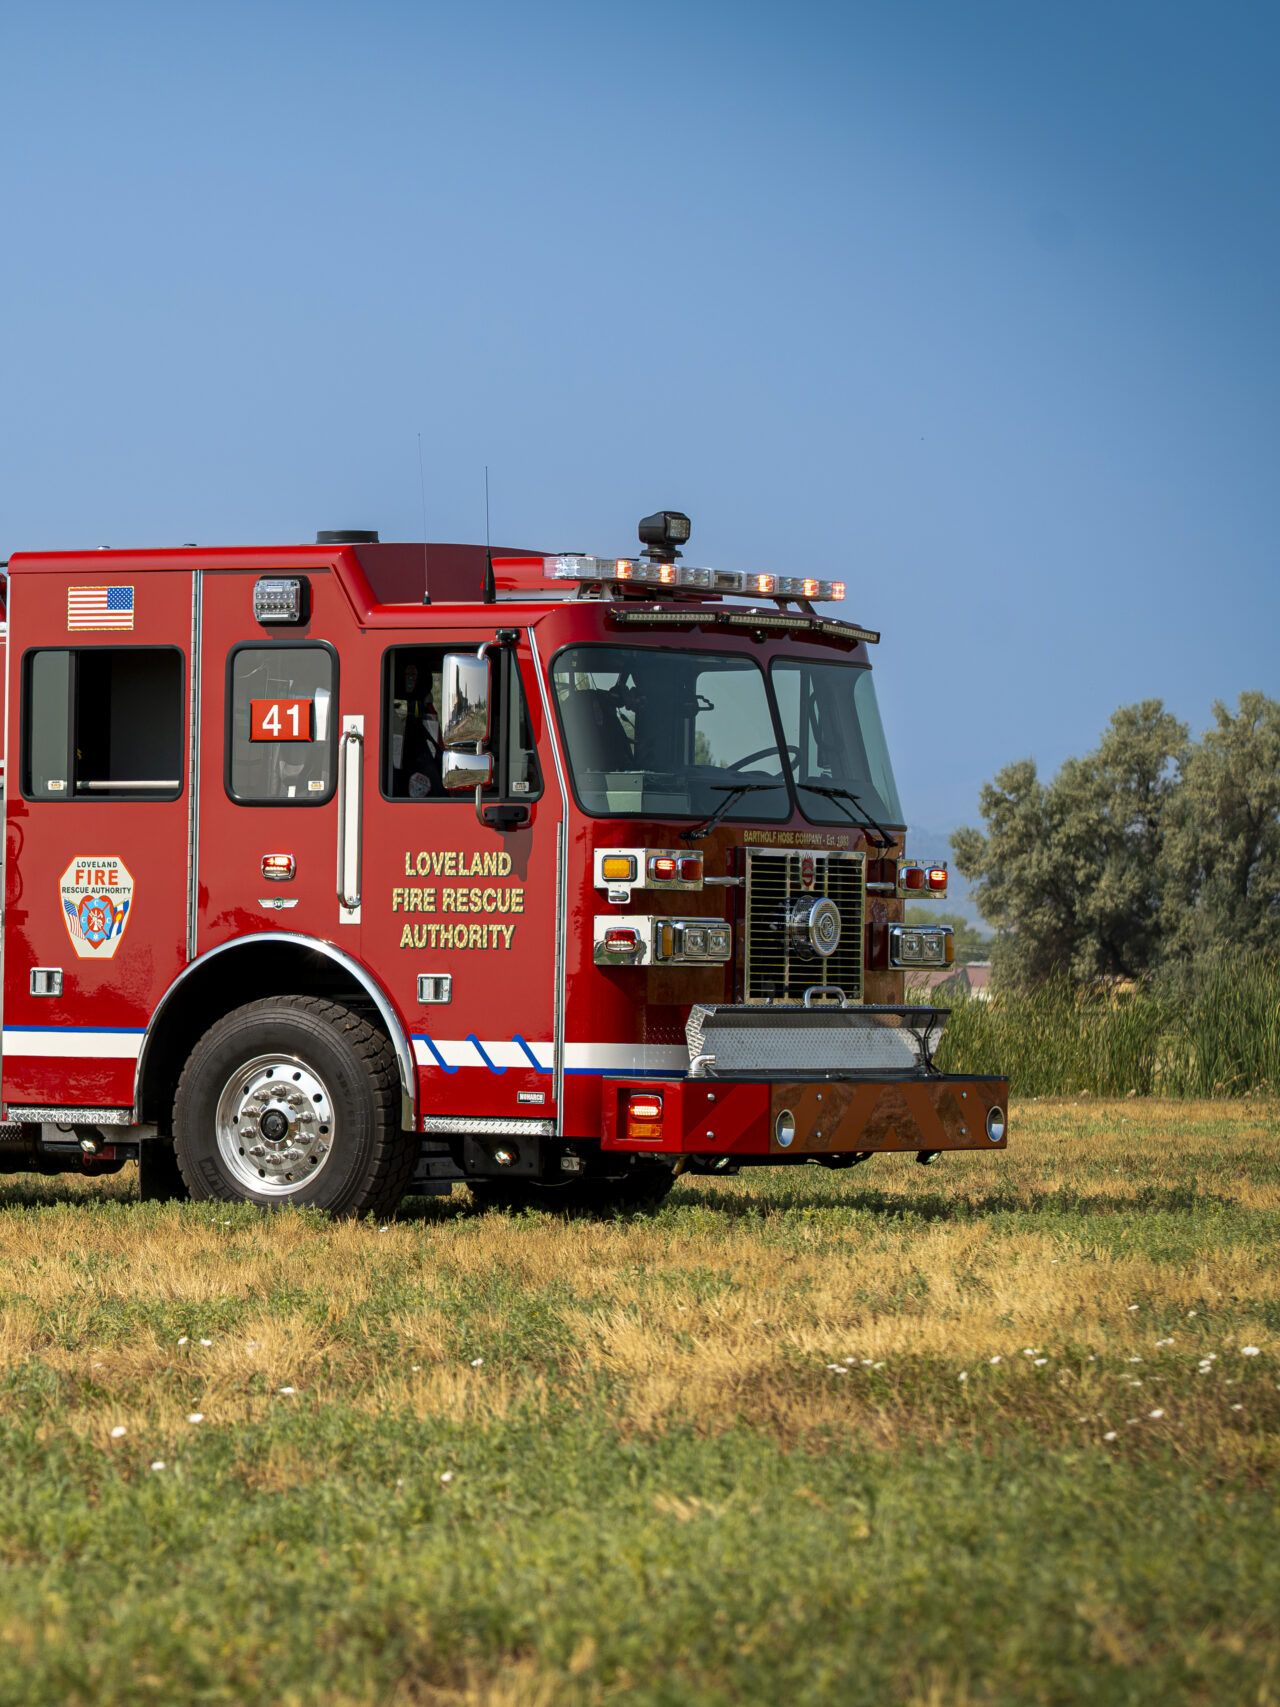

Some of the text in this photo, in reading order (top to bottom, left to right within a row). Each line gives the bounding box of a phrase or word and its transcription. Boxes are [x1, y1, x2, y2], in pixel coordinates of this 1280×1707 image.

[262, 704, 299, 737] 41
[777, 831, 794, 845] HOSE
[795, 832, 823, 846] COMPANY
[405, 851, 512, 877] LOVELAND
[61, 886, 132, 894] RESCUE AUTHORITY
[75, 869, 119, 886] FIRE
[392, 887, 525, 914] FIRE RESCUE
[400, 923, 516, 950] AUTHORITY
